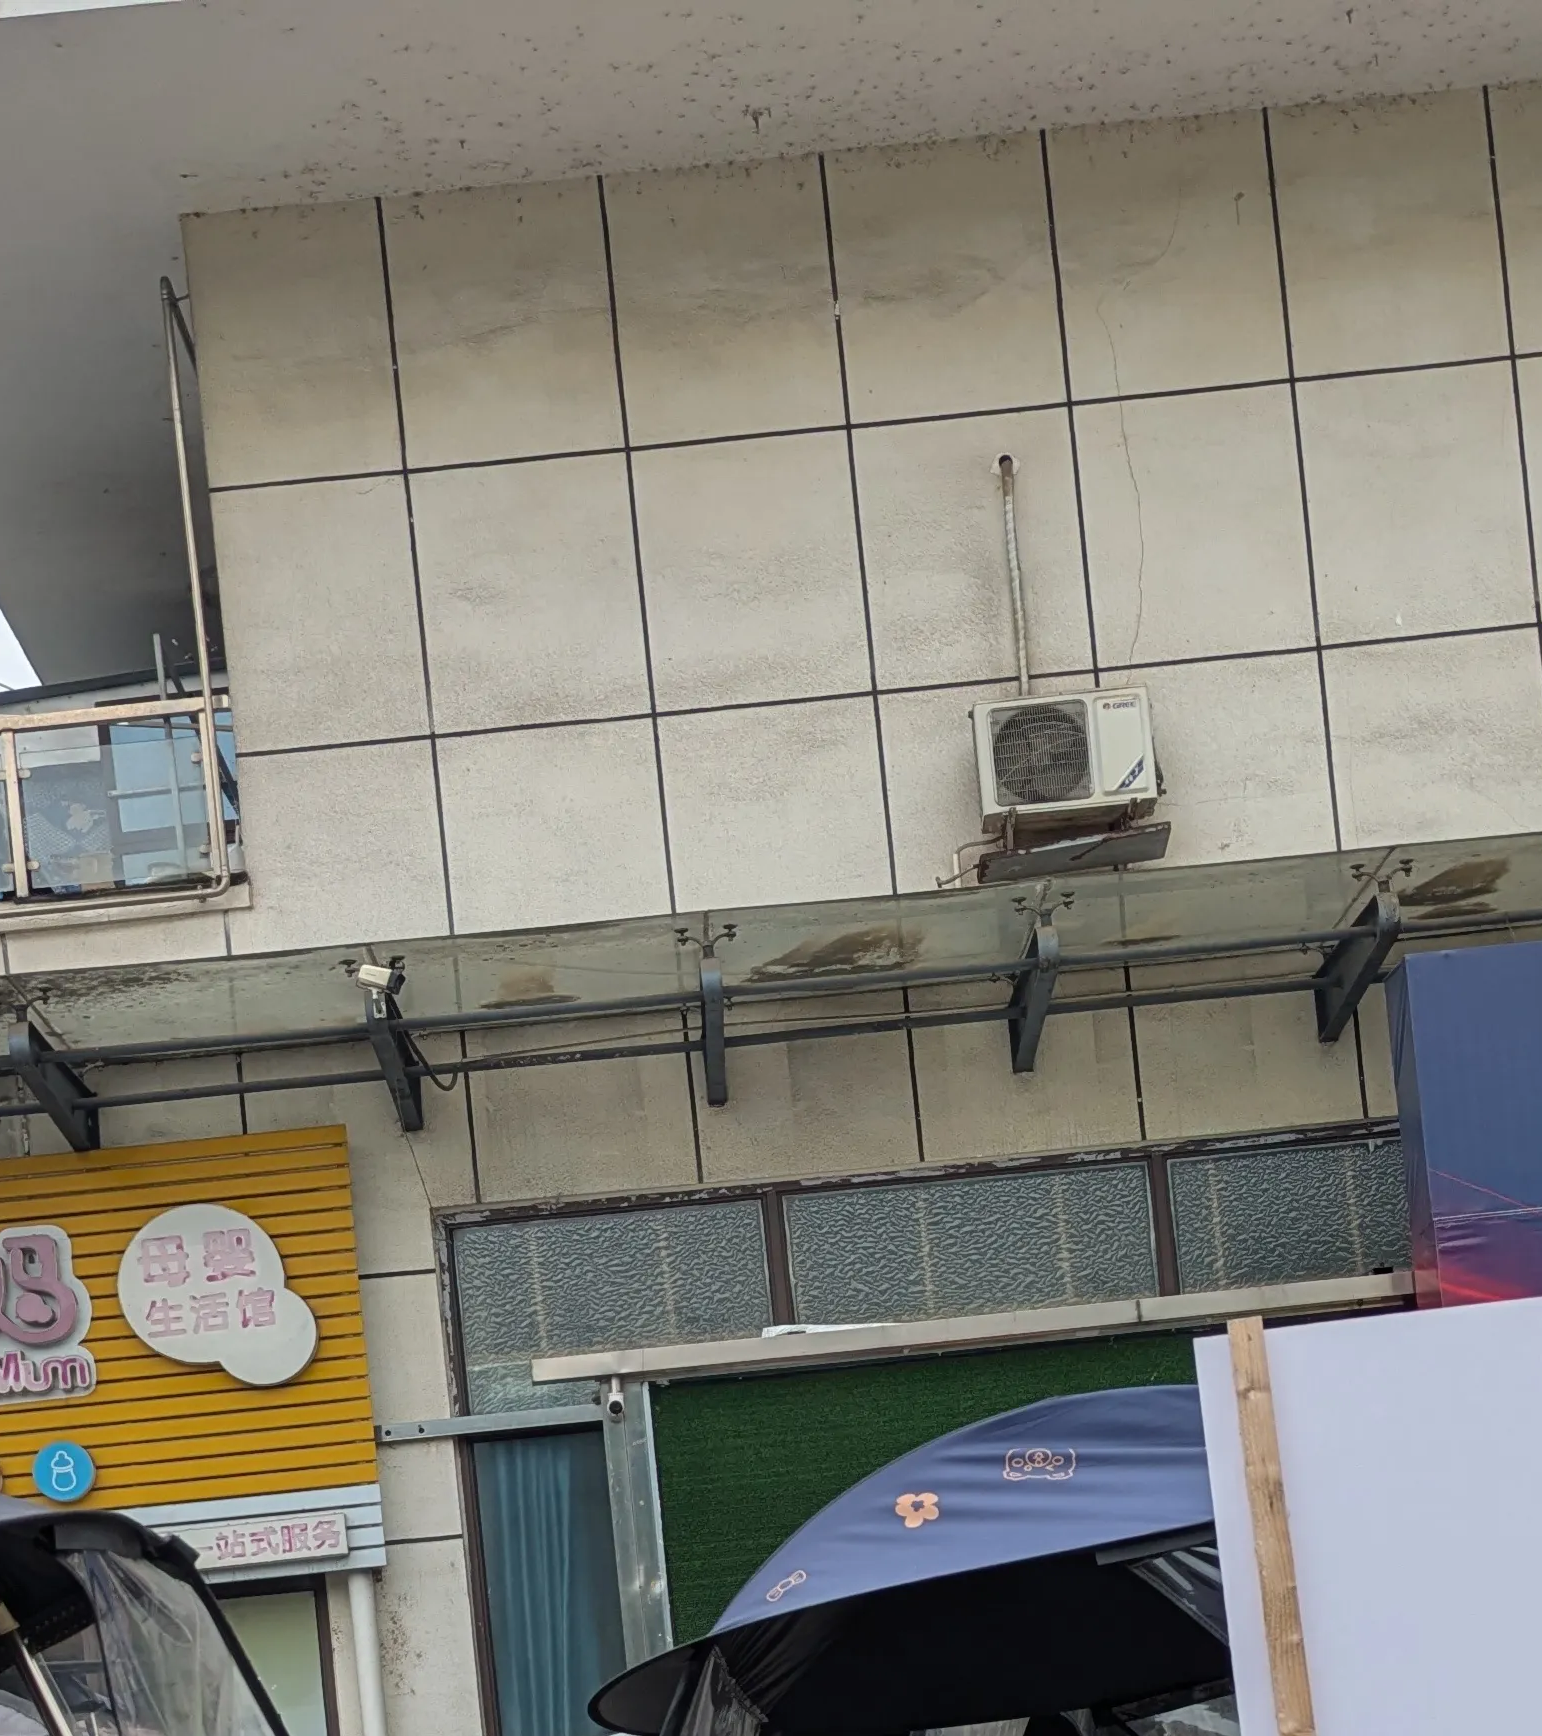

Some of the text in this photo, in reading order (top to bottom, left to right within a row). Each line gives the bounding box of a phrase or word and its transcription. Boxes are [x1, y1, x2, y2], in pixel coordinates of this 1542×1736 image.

[136, 1228, 257, 1288] 母婴
[145, 1287, 276, 1339] 生活馆
